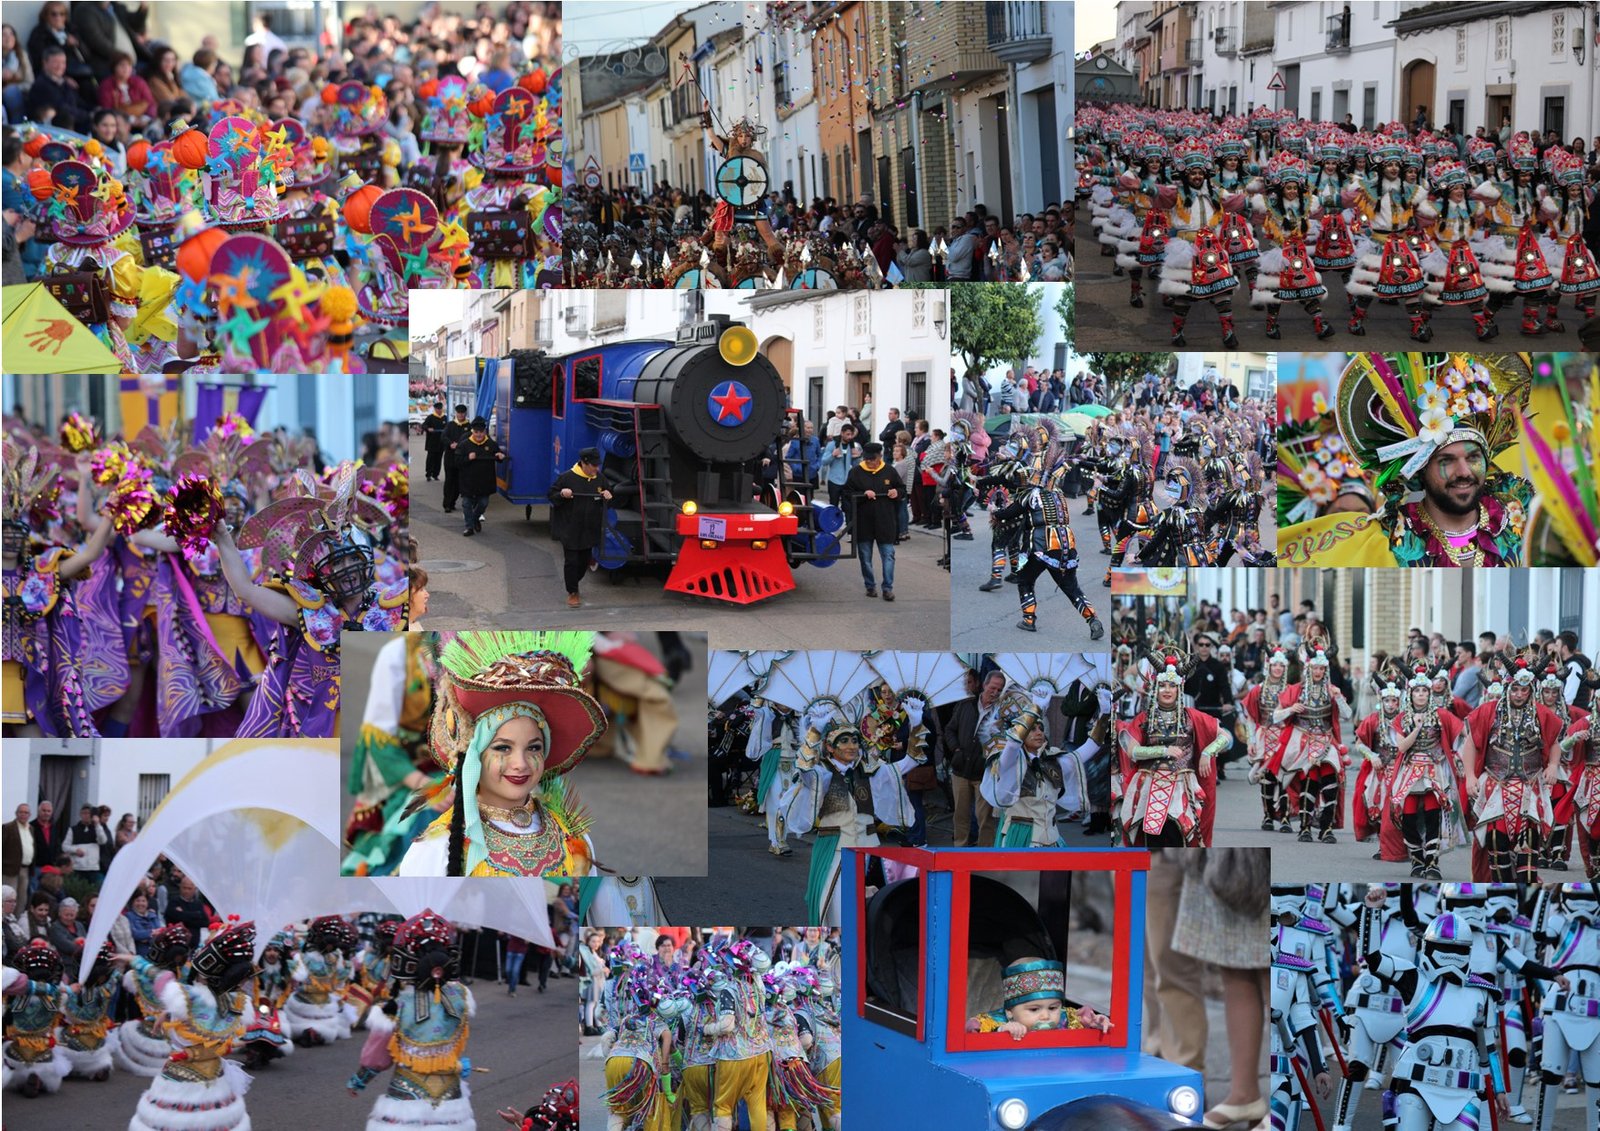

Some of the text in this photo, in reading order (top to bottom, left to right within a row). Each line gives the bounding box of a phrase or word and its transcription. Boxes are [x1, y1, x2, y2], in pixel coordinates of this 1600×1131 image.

[286, 222, 328, 235] MARIA
[474, 221, 518, 231] MARGA
[46, 284, 87, 296] ERY
